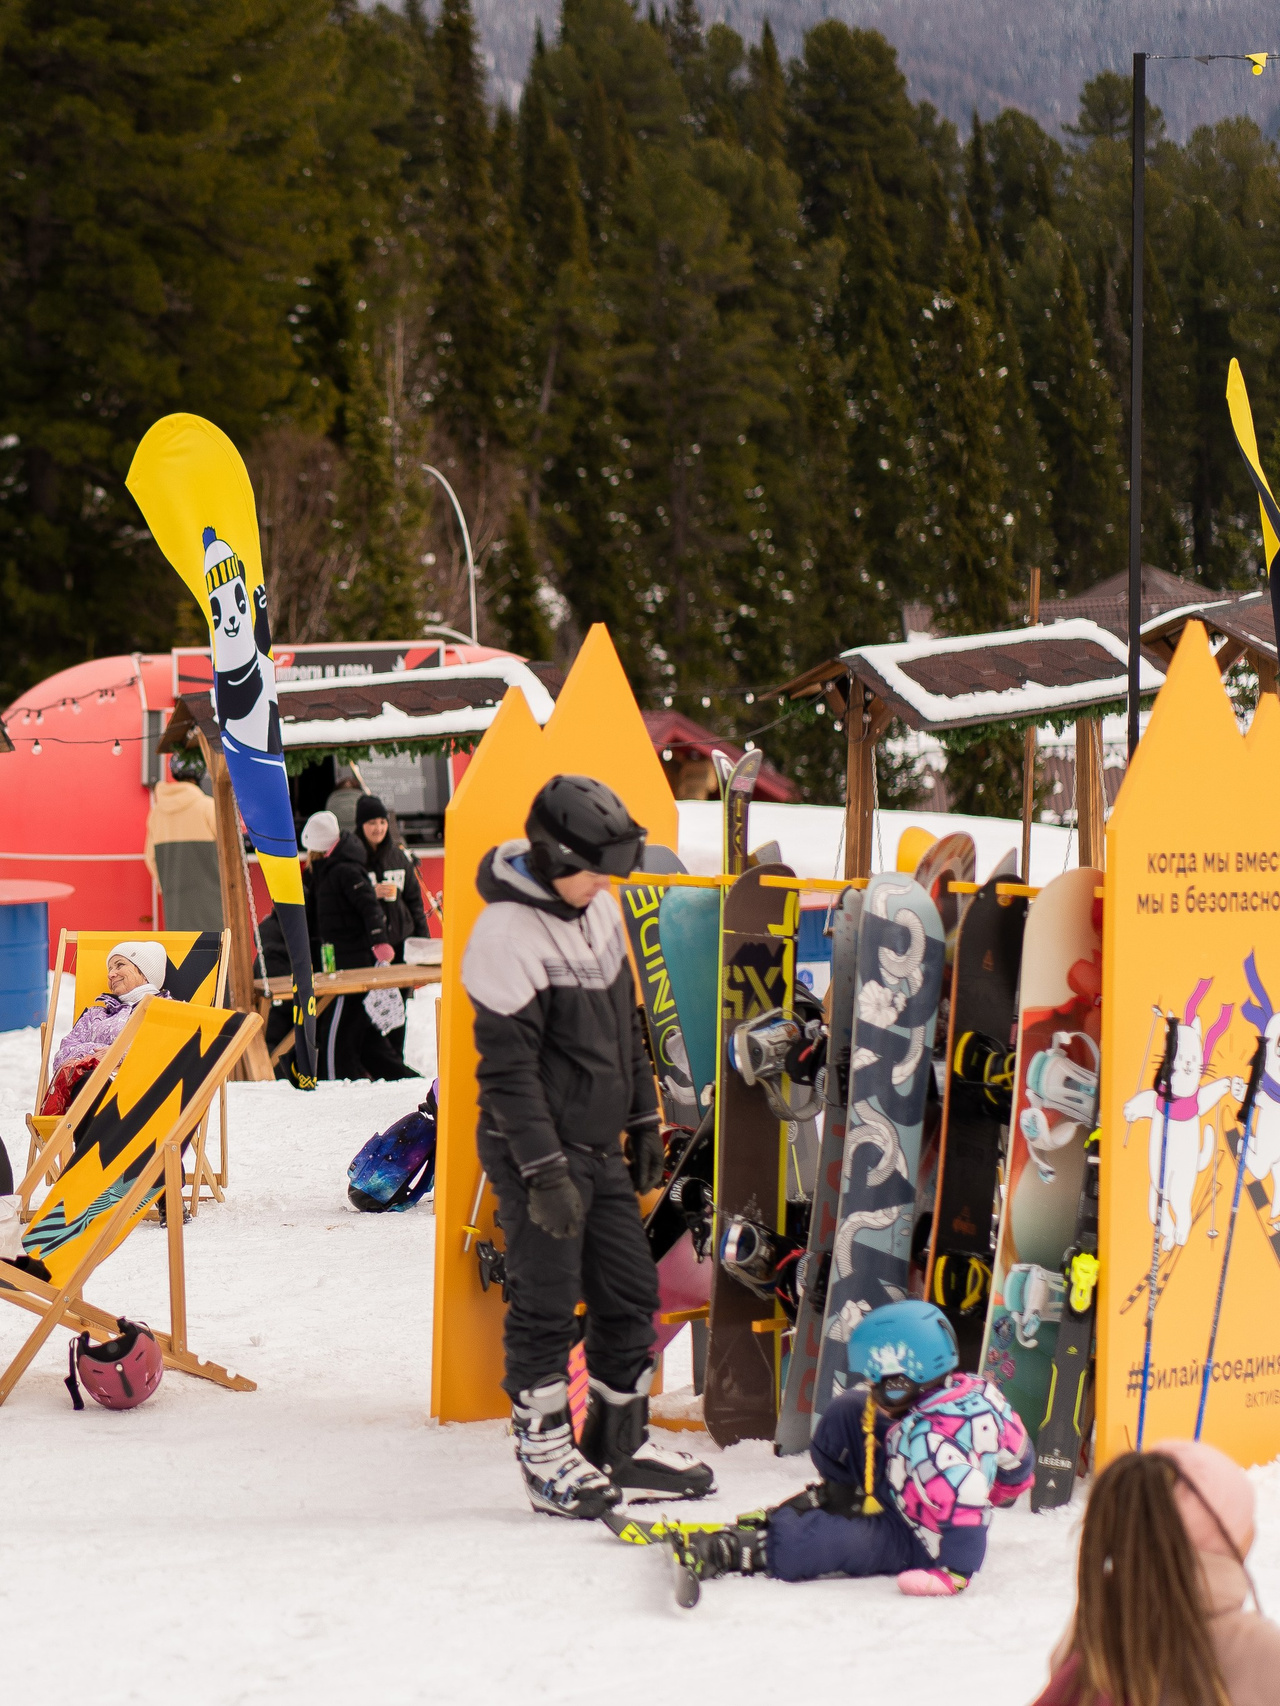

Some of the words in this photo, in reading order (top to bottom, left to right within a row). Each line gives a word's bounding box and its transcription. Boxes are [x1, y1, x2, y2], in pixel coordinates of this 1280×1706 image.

[1147, 852, 1197, 878] когда
[1203, 852, 1230, 873] мы
[1236, 851, 1280, 872] вмес
[1137, 893, 1164, 914] мы
[1171, 892, 1179, 913] в
[1185, 884, 1280, 914] безопасно
[1126, 1354, 1280, 1398] #билайсоедин
[1038, 1455, 1073, 1469] LEGEND
